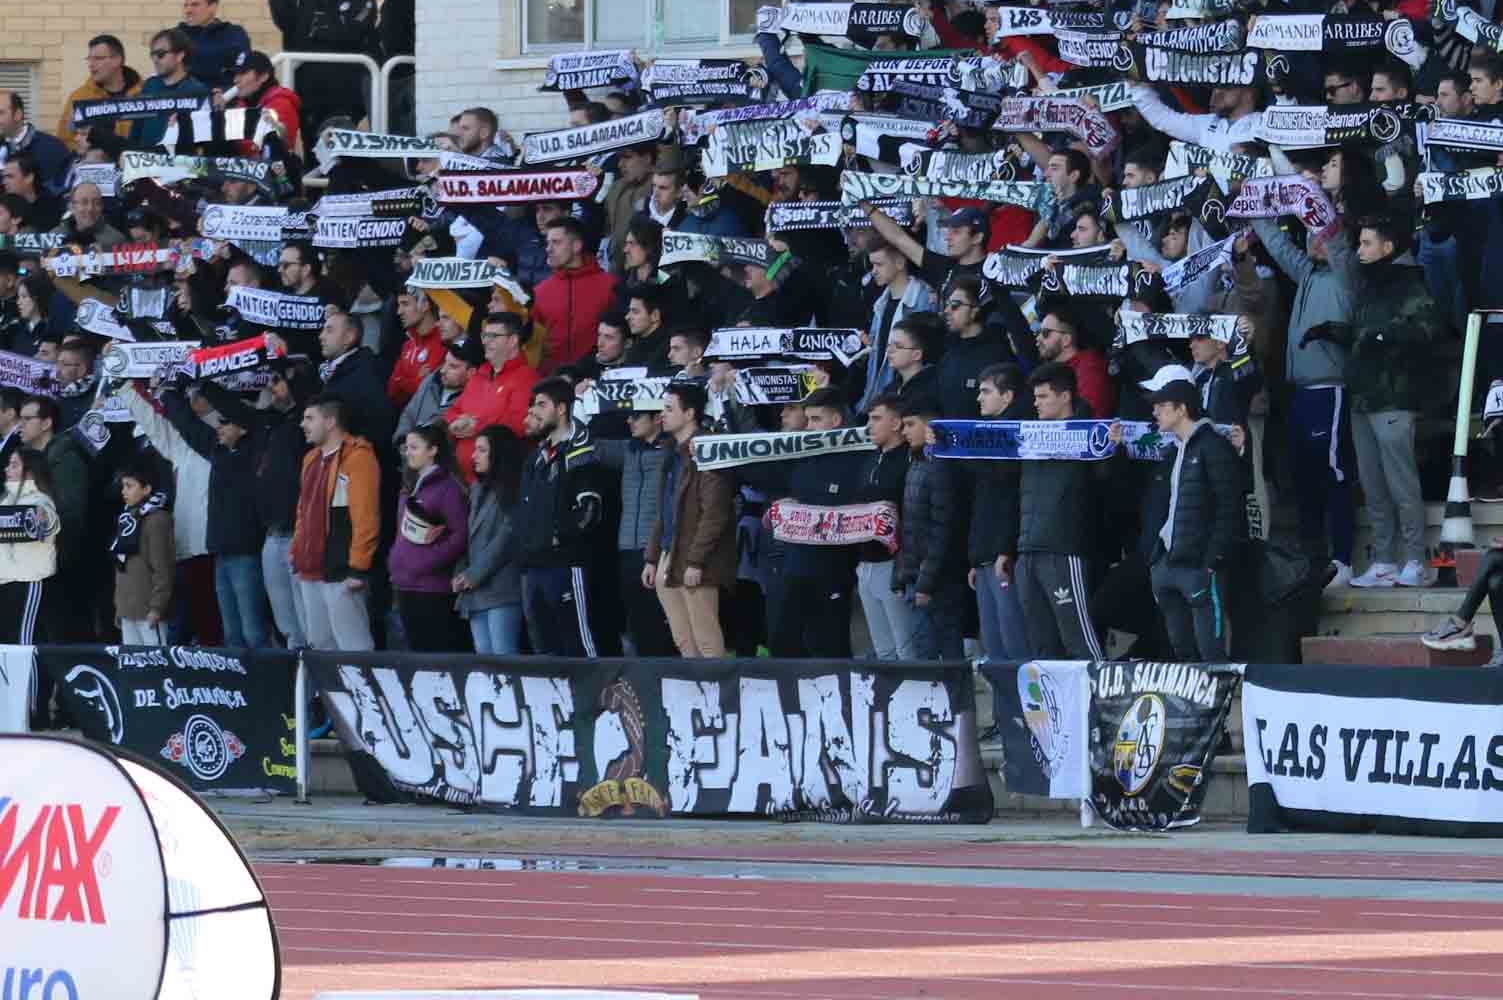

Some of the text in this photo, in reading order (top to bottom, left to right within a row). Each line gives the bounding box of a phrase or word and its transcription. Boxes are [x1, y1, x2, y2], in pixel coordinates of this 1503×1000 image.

[849, 8, 901, 27] ARRIBES
[1009, 10, 1042, 29] LAS
[1324, 21, 1382, 39] ARRIBES
[1144, 49, 1258, 85] UNIONISTAS
[85, 102, 118, 117] UNIÓN
[118, 100, 144, 113] SOLO
[176, 97, 199, 110] UNA
[1323, 111, 1368, 129] Salamanca
[539, 118, 646, 154] U.D. SALAMANCA
[442, 175, 575, 198] U.D. SALAMANCA
[730, 331, 772, 350] HALA
[133, 677, 248, 709] DE SALAMANCA
[1099, 663, 1218, 709] U.D. SALAMANCA
[660, 674, 962, 813] FANS
[1255, 717, 1328, 782] LAS
